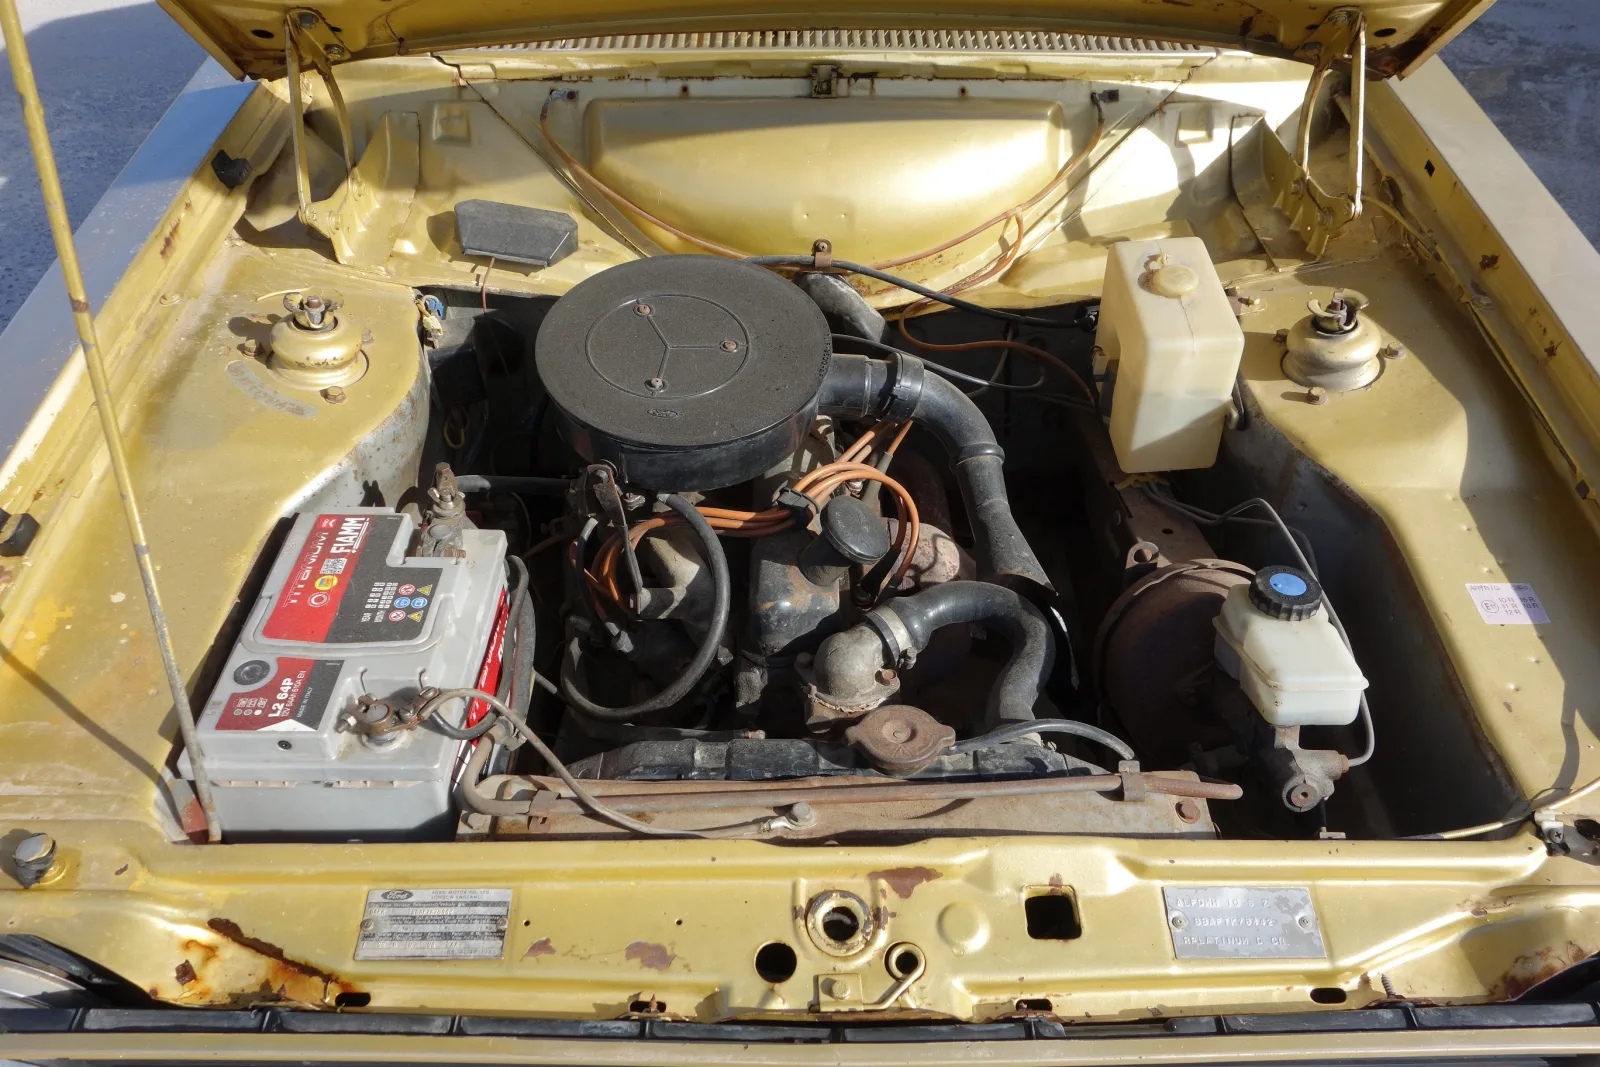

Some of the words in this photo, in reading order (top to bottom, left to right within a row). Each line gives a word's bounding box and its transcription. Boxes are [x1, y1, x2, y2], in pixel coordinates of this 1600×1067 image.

[329, 517, 366, 554] FIAMM
[360, 612, 372, 623] YEAR
[267, 702, 285, 717] L2
[276, 677, 294, 700] 64P
[281, 708, 291, 718] 12V
[296, 705, 306, 718] MADE
[304, 686, 313, 699] ITALY
